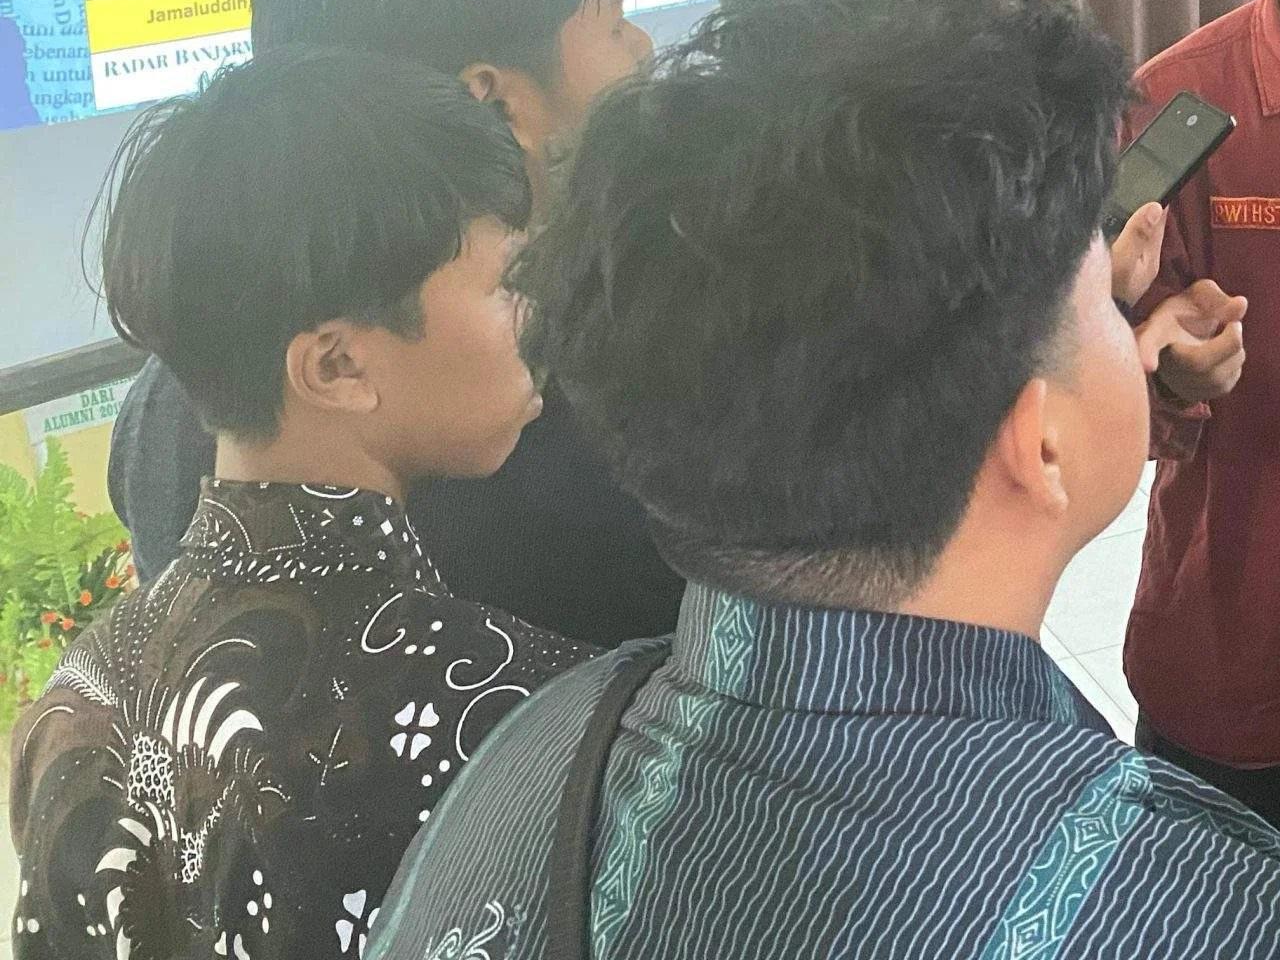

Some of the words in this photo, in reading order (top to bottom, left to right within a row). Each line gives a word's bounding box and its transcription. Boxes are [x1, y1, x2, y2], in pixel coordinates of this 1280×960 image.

[104, 54, 169, 78] RADAR
[80, 387, 116, 408] DARI
[43, 409, 96, 433] ALUMNI
